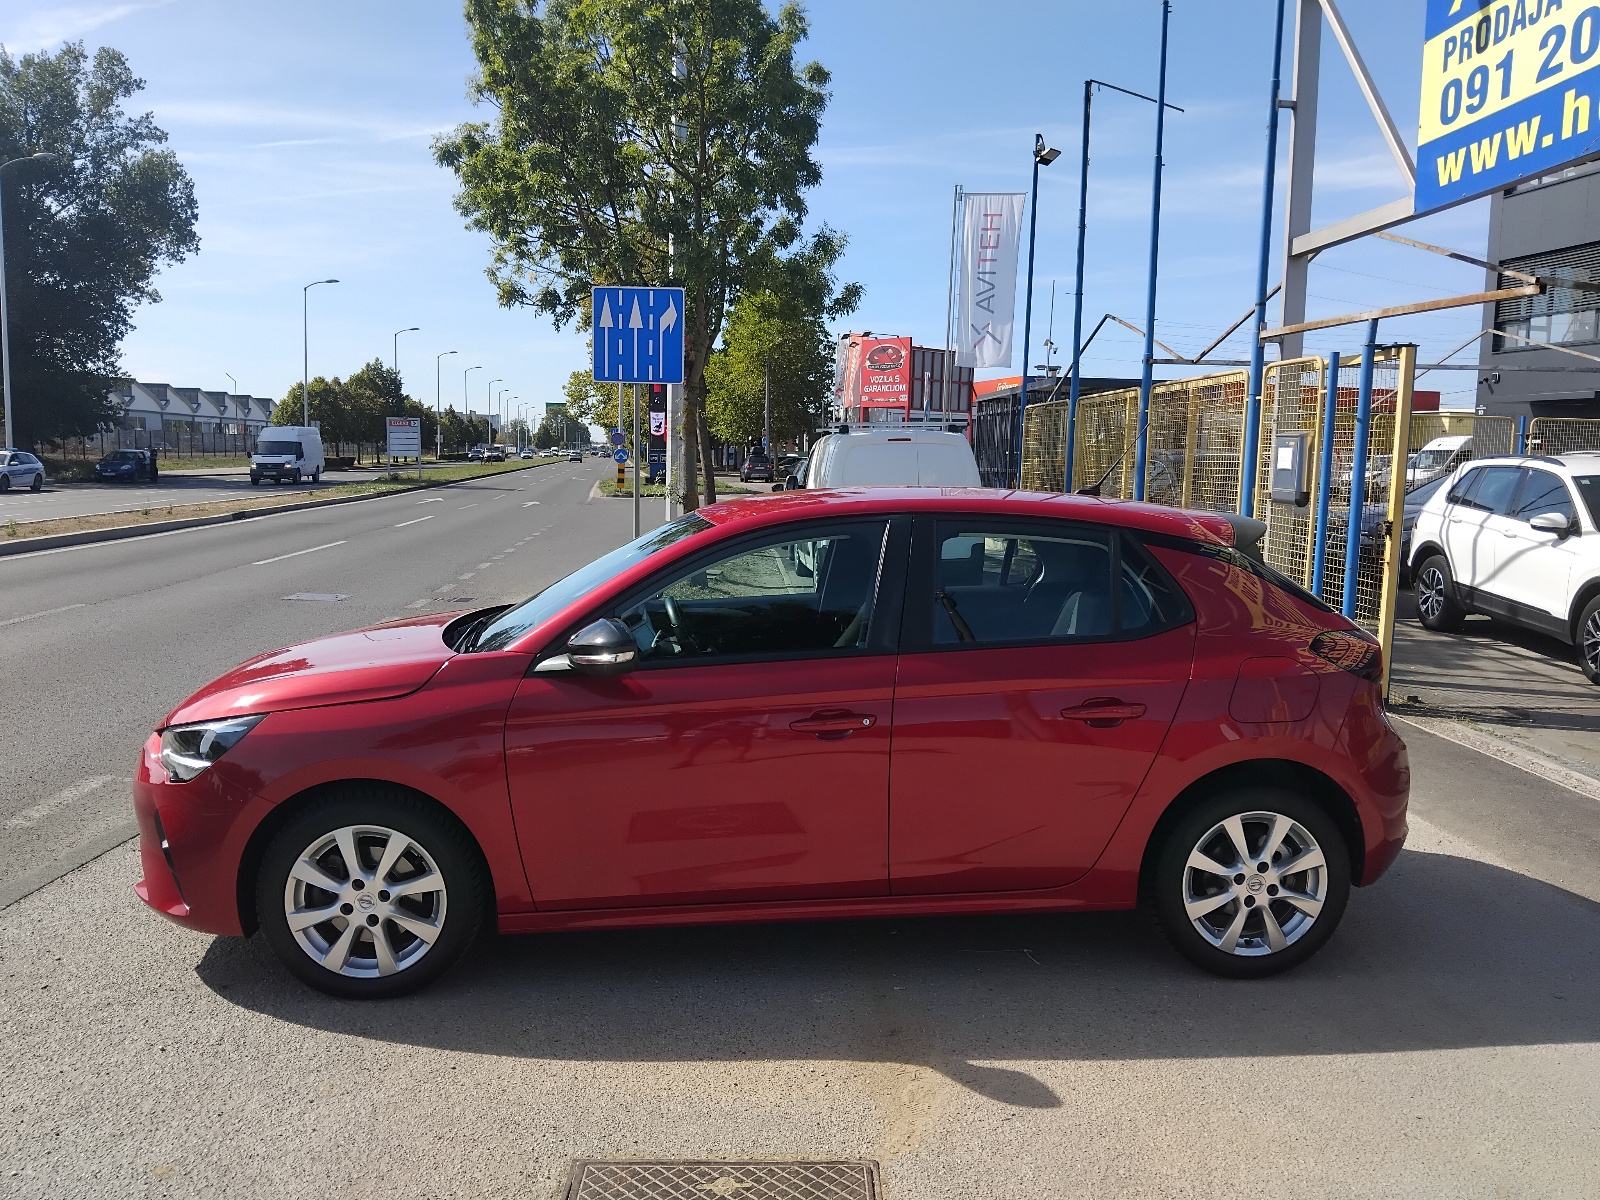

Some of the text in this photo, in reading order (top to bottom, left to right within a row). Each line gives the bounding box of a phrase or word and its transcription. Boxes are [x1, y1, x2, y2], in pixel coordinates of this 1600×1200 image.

[1440, 5, 1600, 126] 091 20
[1436, 88, 1600, 187] www.h
[975, 213, 1003, 314] AVITEH
[863, 384, 906, 393] GARANCIJOM
[870, 375, 900, 384] VOZILA S
